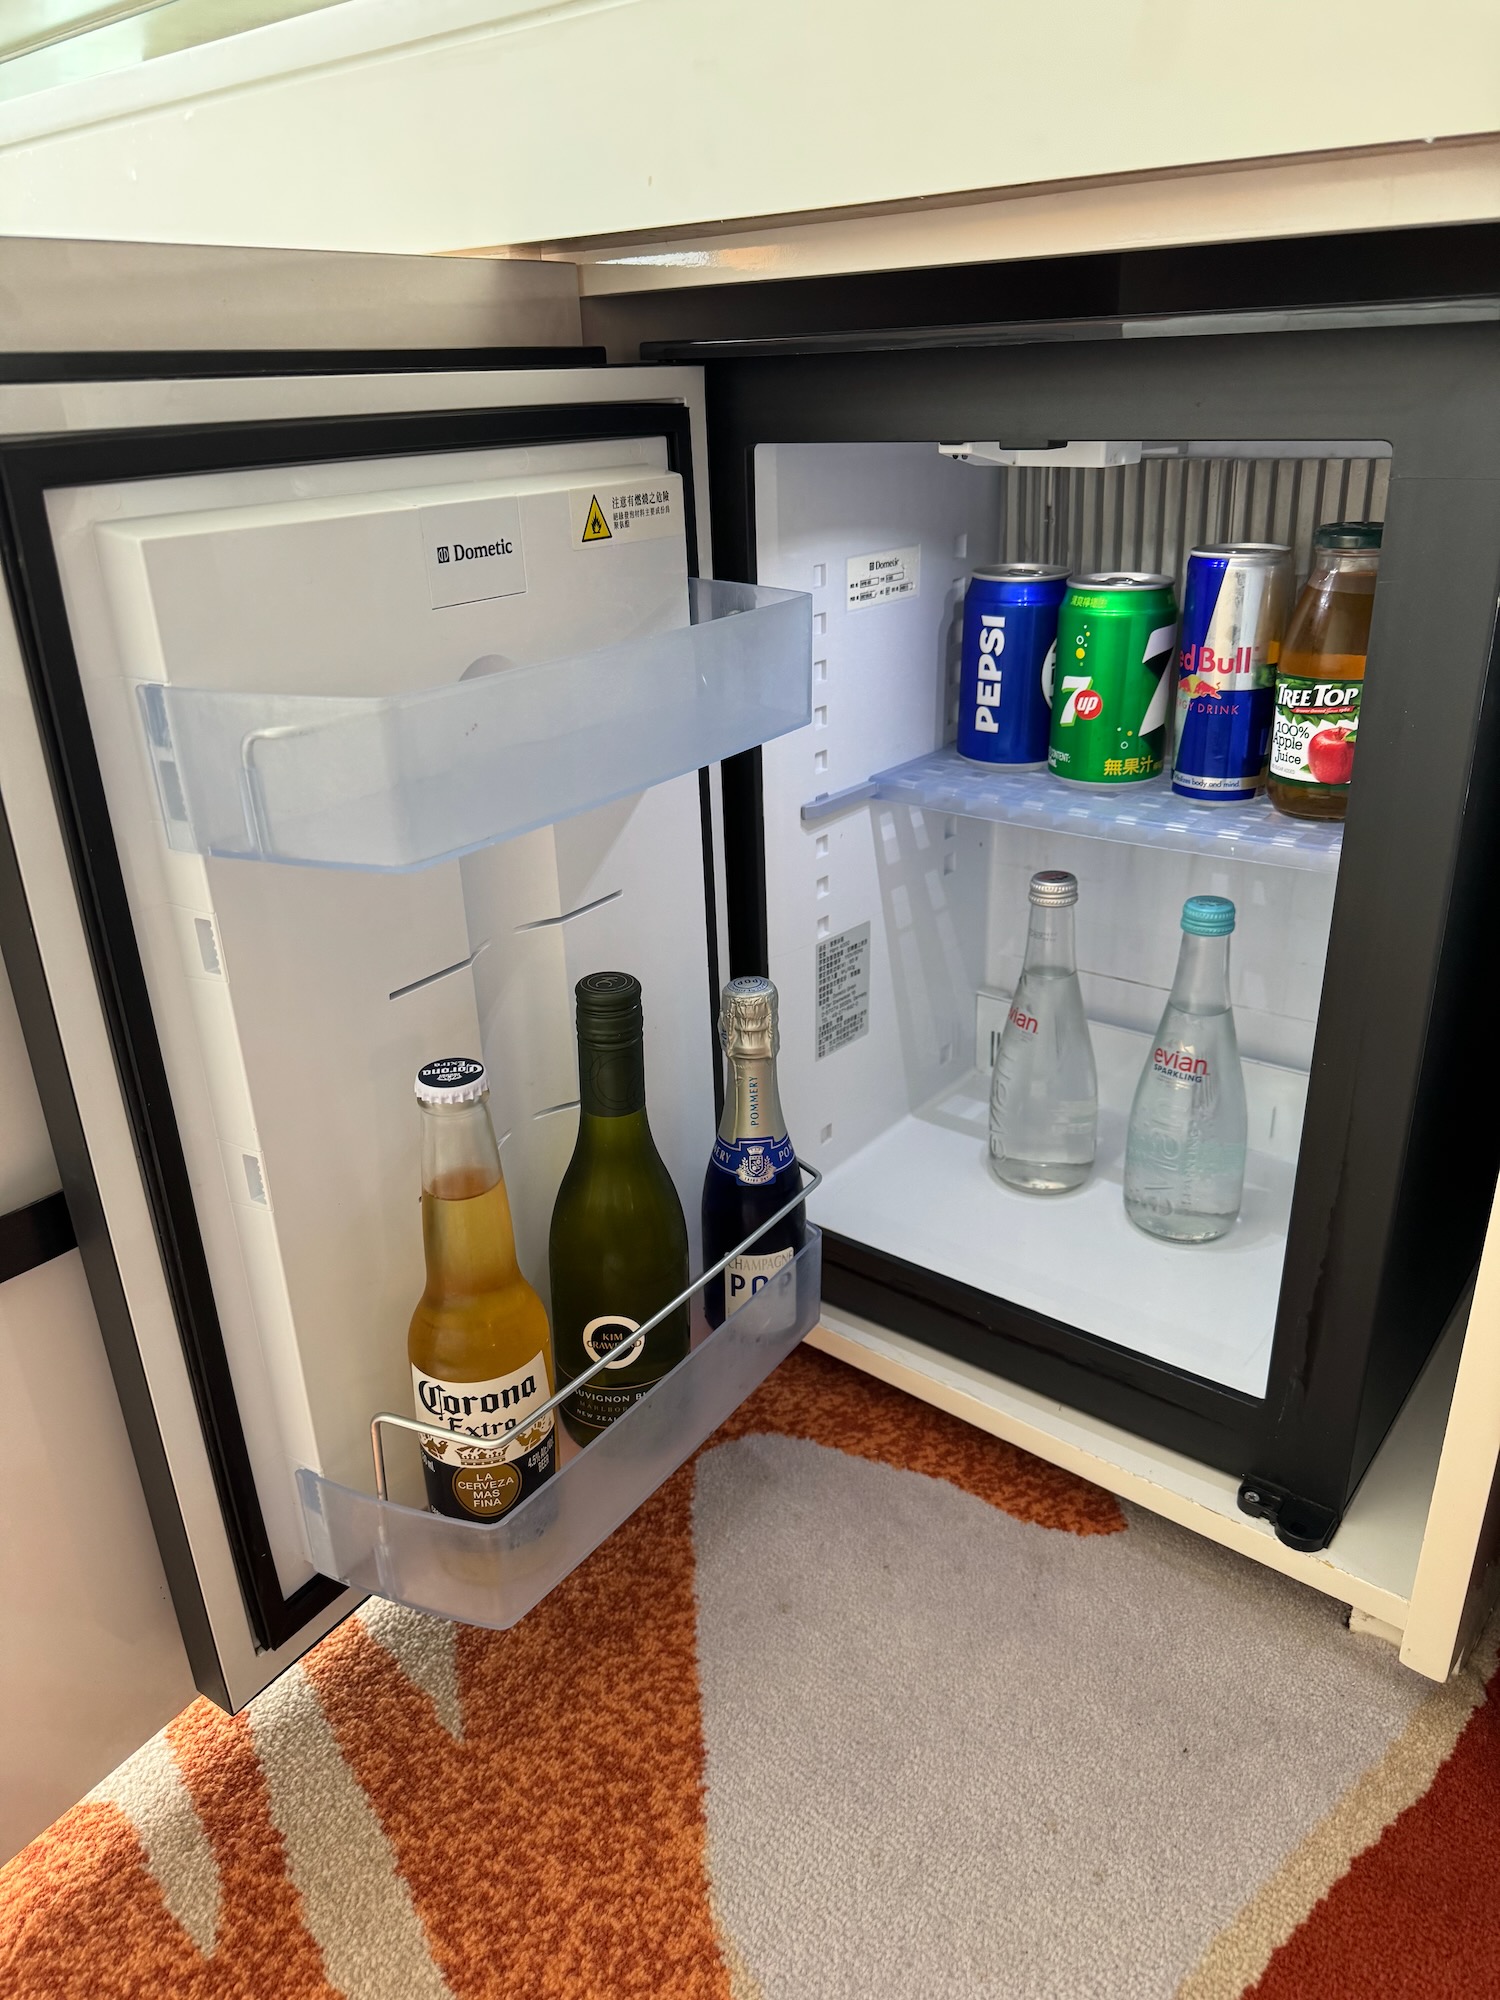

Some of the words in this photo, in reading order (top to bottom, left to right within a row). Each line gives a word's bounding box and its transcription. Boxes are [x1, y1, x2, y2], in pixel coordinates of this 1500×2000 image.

[454, 538, 513, 562] Dometic
[1199, 646, 1252, 674] Bull
[975, 614, 1006, 733] PEPSI
[1278, 683, 1313, 709] TREE
[1313, 684, 1360, 707] TOP
[1197, 703, 1240, 715] DRINK
[1276, 721, 1310, 738] 100%
[1272, 731, 1303, 751] Apple
[1104, 756, 1153, 776] 無果汁
[1192, 778, 1207, 788] body
[1209, 779, 1222, 788] and
[422, 1063, 484, 1076] Corona
[434, 1060, 466, 1068] Extra
[1154, 1047, 1208, 1075] evian
[1154, 1063, 1203, 1083] SPARKLING
[750, 1076, 758, 1127] POMMERY
[602, 1333, 623, 1341] KIM
[418, 1375, 537, 1420] Corona
[577, 1408, 593, 1418] NEW
[448, 1417, 517, 1438] Extra
[457, 1476, 514, 1490] CERVEZA
[476, 1473, 493, 1482] LA
[473, 1490, 500, 1499] MAS
[473, 1499, 502, 1508] FINA
